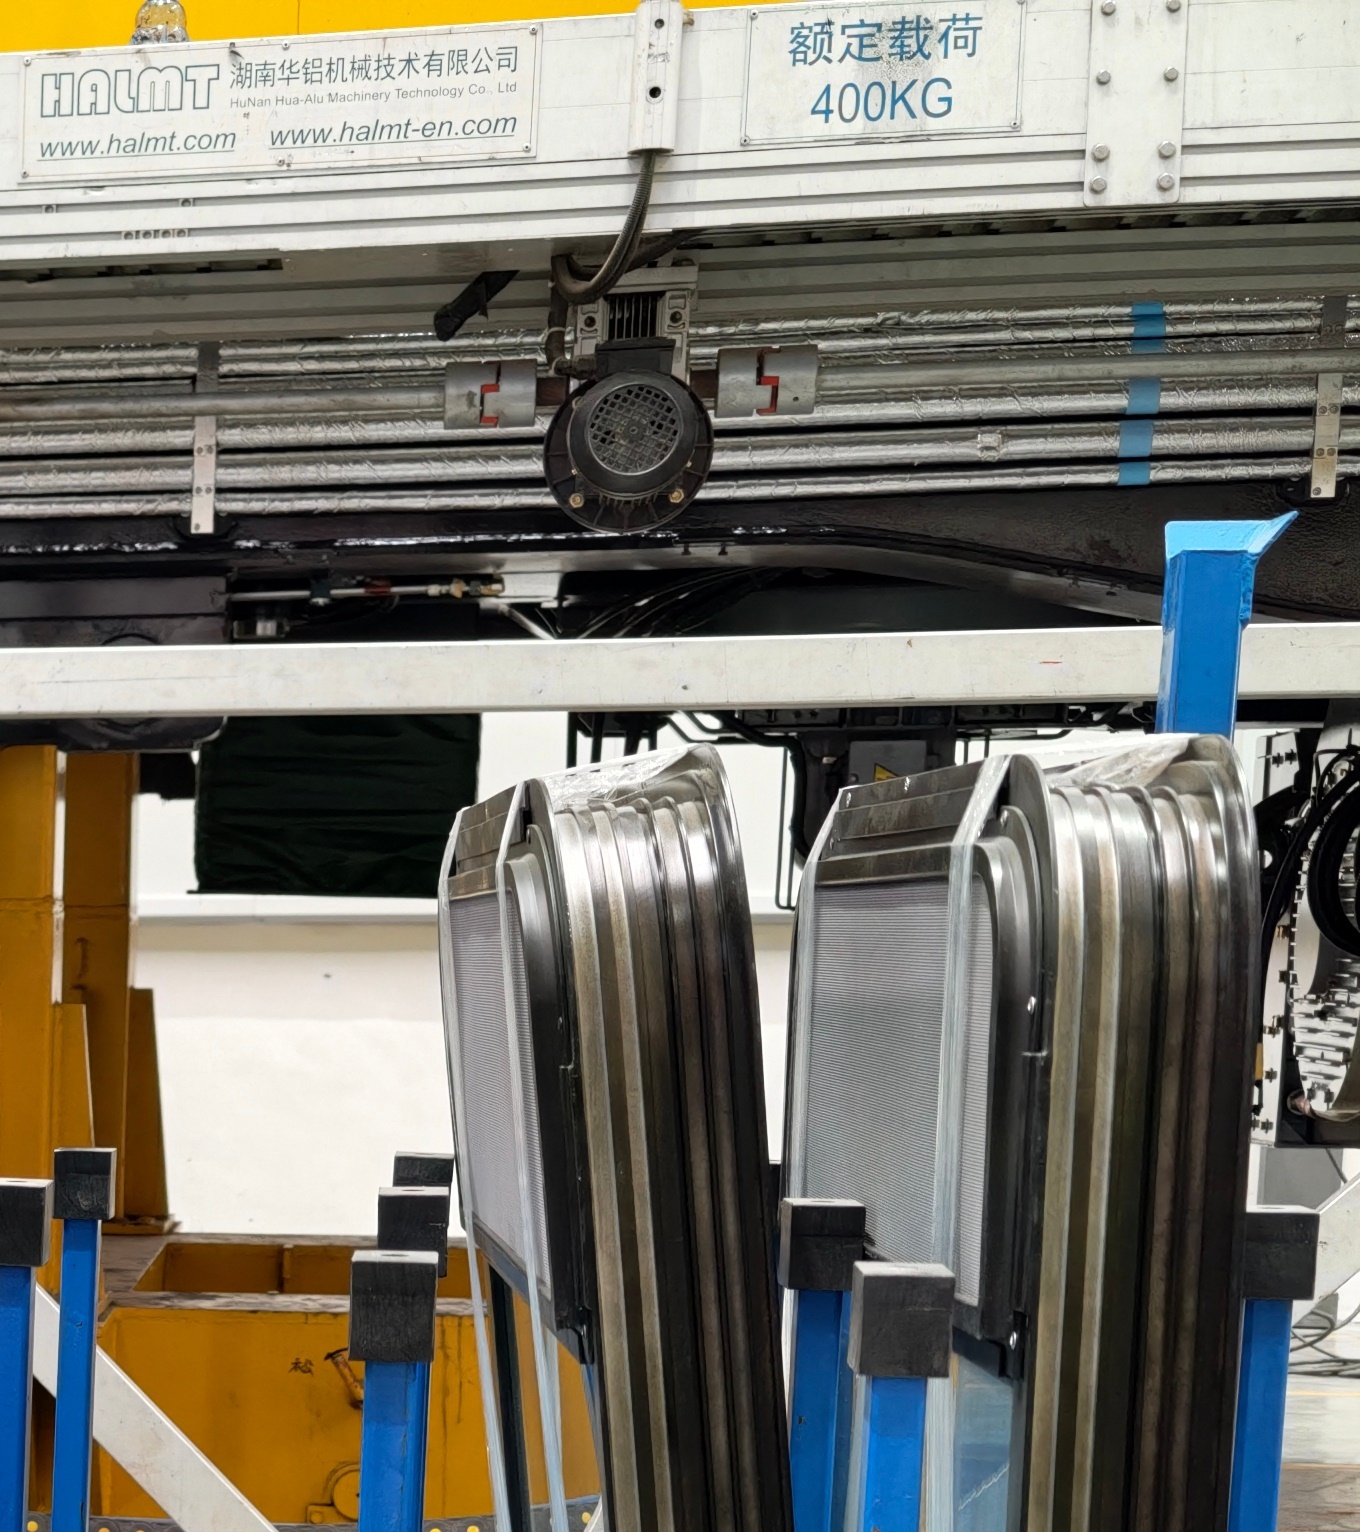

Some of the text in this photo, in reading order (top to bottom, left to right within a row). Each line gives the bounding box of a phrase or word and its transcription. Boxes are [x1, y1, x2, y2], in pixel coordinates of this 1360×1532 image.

[788, 12, 983, 67] 额定载荷
[229, 46, 518, 89] 湖南华铝机械技术有限公司
[40, 63, 220, 118] HALMT
[275, 93, 324, 106] Hua-Alu
[327, 90, 391, 103] Machinery
[395, 86, 464, 99] Technology
[497, 81, 517, 94] Ltd
[810, 77, 953, 124] 400KG
[39, 116, 517, 158] www.halmt.com www.halmt-en.com
